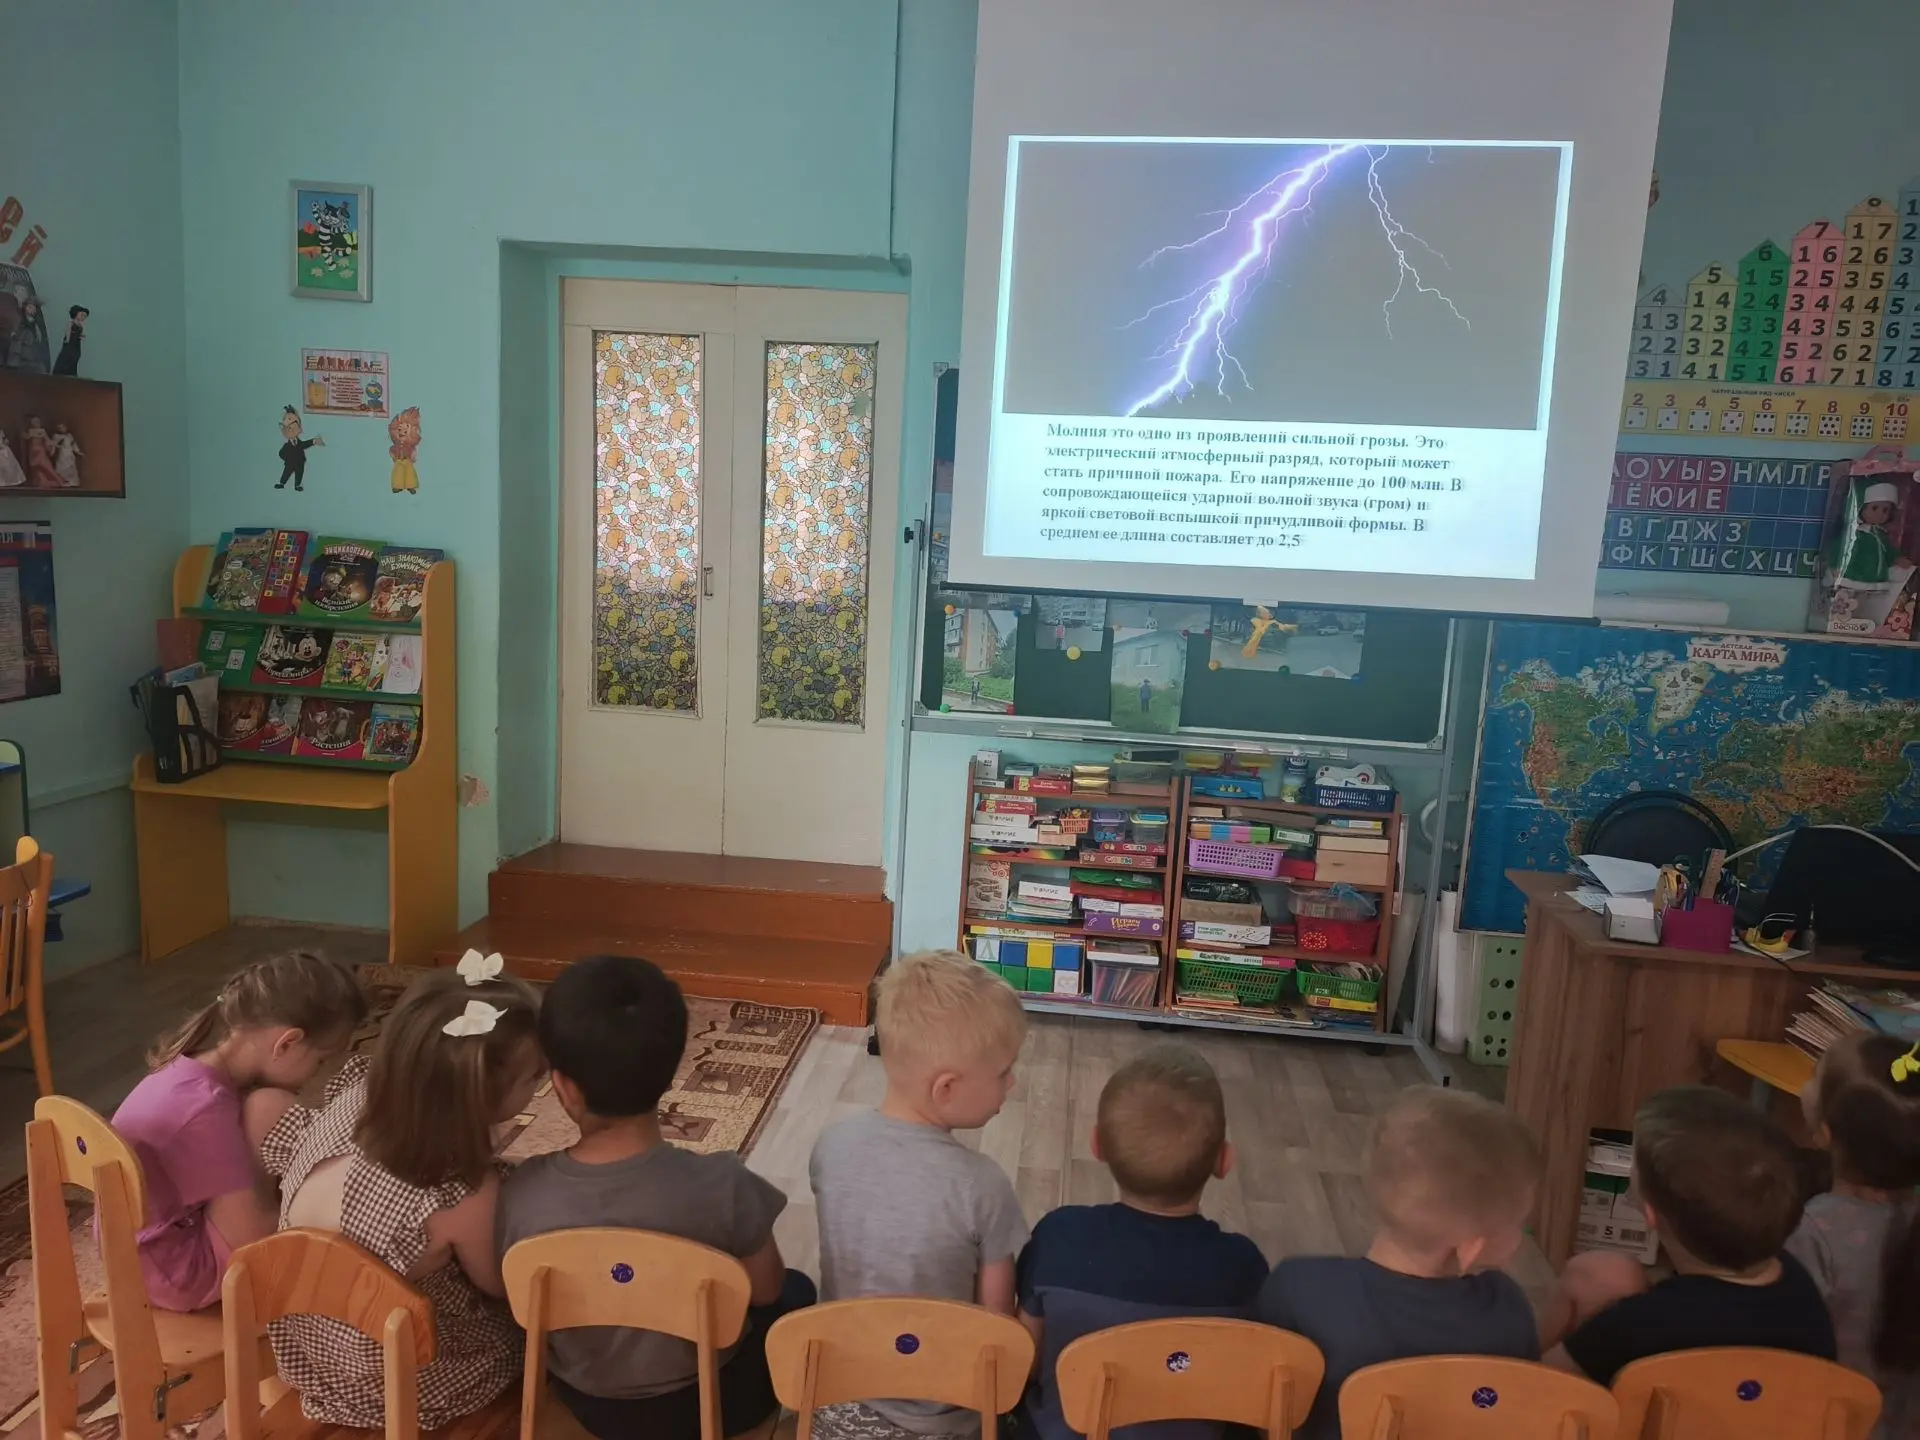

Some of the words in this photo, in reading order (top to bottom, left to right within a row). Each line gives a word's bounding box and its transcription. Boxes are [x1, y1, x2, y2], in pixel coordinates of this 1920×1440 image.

[1815, 222, 1829, 238] 7
[1853, 223, 1864, 239] 1
[1878, 223, 1892, 239] 7
[1759, 245, 1772, 261] 6
[1799, 246, 1810, 262] 1
[1823, 246, 1837, 262] 6
[1849, 247, 1863, 263] 2
[1874, 247, 1888, 264] 6
[1708, 267, 1721, 283] 5
[1745, 270, 1757, 285] 1
[1769, 270, 1783, 285] 5
[1794, 270, 1808, 286] 2
[1819, 270, 1834, 287] 5
[1844, 272, 1859, 288] 3
[1870, 272, 1884, 289] 5
[1653, 290, 1666, 305] 4
[1694, 290, 1704, 306] 1
[1716, 292, 1730, 307] 4
[1741, 292, 1755, 308] 2
[1765, 293, 1780, 309] 4
[1790, 294, 1804, 310] 3
[1814, 295, 1829, 311] 4
[1840, 296, 1854, 312] 4
[1865, 296, 1879, 312] 4
[1690, 315, 1704, 331] 2
[1713, 315, 1727, 331] 3
[1738, 316, 1751, 332] 3
[1763, 317, 1777, 333] 3
[1787, 319, 1800, 335] 4
[1811, 319, 1825, 335] 3
[1836, 320, 1850, 336] 5
[1861, 321, 1875, 337] 3
[1886, 322, 1899, 338] 6
[1686, 338, 1700, 354] 3
[1711, 339, 1724, 355] 2
[1735, 340, 1749, 356] 4
[1759, 341, 1773, 357] 2
[1783, 343, 1798, 359] 5
[1808, 344, 1822, 359] 2
[1833, 344, 1847, 361] 6
[1858, 345, 1871, 361] 2
[1884, 346, 1897, 362] 7
[1682, 363, 1696, 378] 4
[1707, 364, 1718, 379] 1
[1731, 364, 1745, 380] 5
[1757, 365, 1768, 381] 1
[1780, 366, 1794, 383] 6
[1805, 367, 1816, 383] 1
[1830, 369, 1844, 384] 7
[1855, 369, 1866, 385] 1
[1878, 371, 1892, 386] 8
[1903, 371, 1914, 387] 1
[1634, 393, 1644, 406] 2
[1666, 395, 1676, 407] 3
[1696, 396, 1706, 408] 4
[1729, 397, 1739, 409] 5
[1761, 399, 1772, 410] 6
[1796, 400, 1806, 412] 7
[1828, 401, 1838, 413] 8
[1860, 403, 1870, 414] 9
[1886, 404, 1908, 416] 10
[1658, 459, 1675, 478] У
[1681, 460, 1702, 480] Ы
[1708, 462, 1727, 481] Э
[1734, 462, 1751, 483] Н
[1757, 462, 1782, 484] М
[1787, 464, 1806, 485] Л
[1627, 484, 1642, 506] Ё
[1650, 486, 1672, 507] Ю
[1676, 488, 1696, 508] И
[1707, 489, 1721, 509] Е
[1619, 518, 1632, 537] В
[1646, 519, 1660, 538] Г
[1667, 521, 1688, 542] Д
[1694, 522, 1717, 541] Ж
[1727, 523, 1741, 542] З
[1611, 545, 1633, 563] Ф
[1641, 547, 1657, 565] К
[1670, 547, 1686, 566] Т
[1691, 549, 1715, 568] Ш
[1721, 550, 1739, 568] С
[1747, 551, 1764, 570] Х
[1775, 553, 1793, 573] Ц
[1692, 647, 1738, 661] КАРТА
[1740, 650, 1781, 664] МИРА
